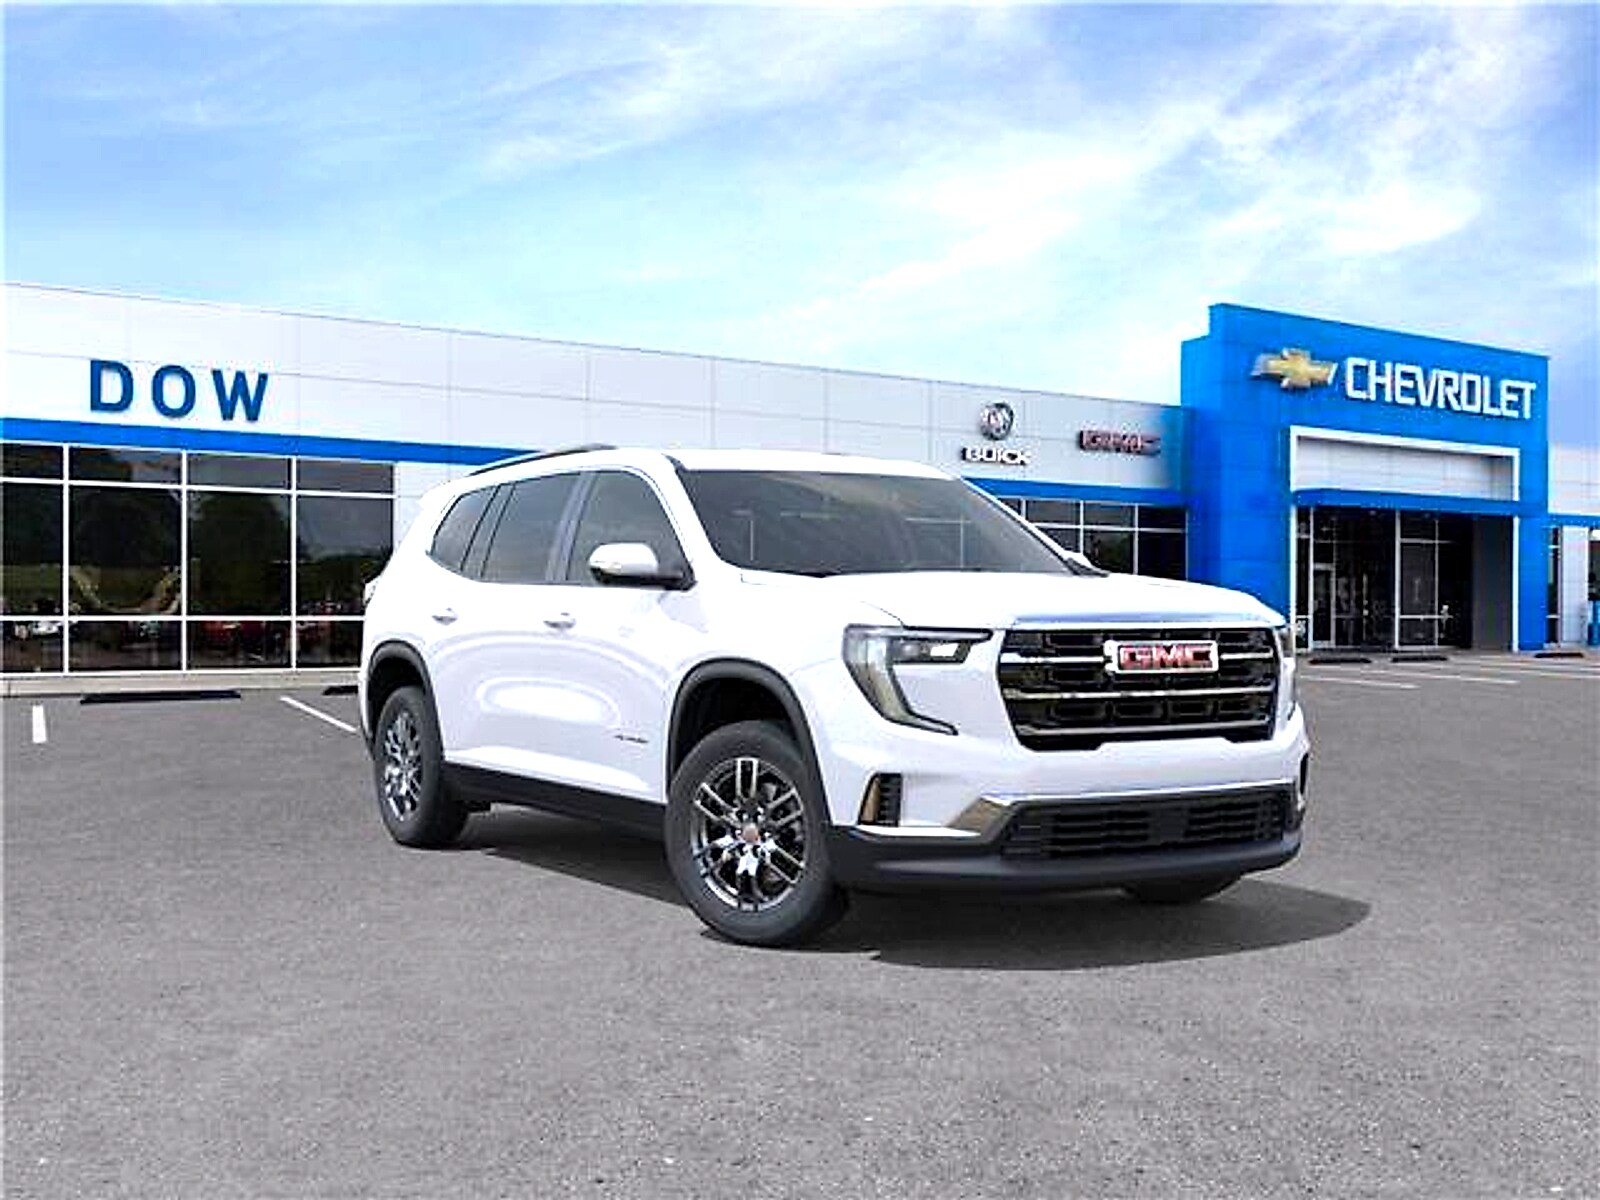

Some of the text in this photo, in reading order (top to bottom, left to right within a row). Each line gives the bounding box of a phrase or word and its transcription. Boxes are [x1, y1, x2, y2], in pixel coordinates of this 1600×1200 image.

[90, 359, 268, 421] DOW
[1344, 357, 1536, 419] CHEVROLET
[962, 446, 1031, 466] BUICK
[1119, 643, 1214, 670] GMC
